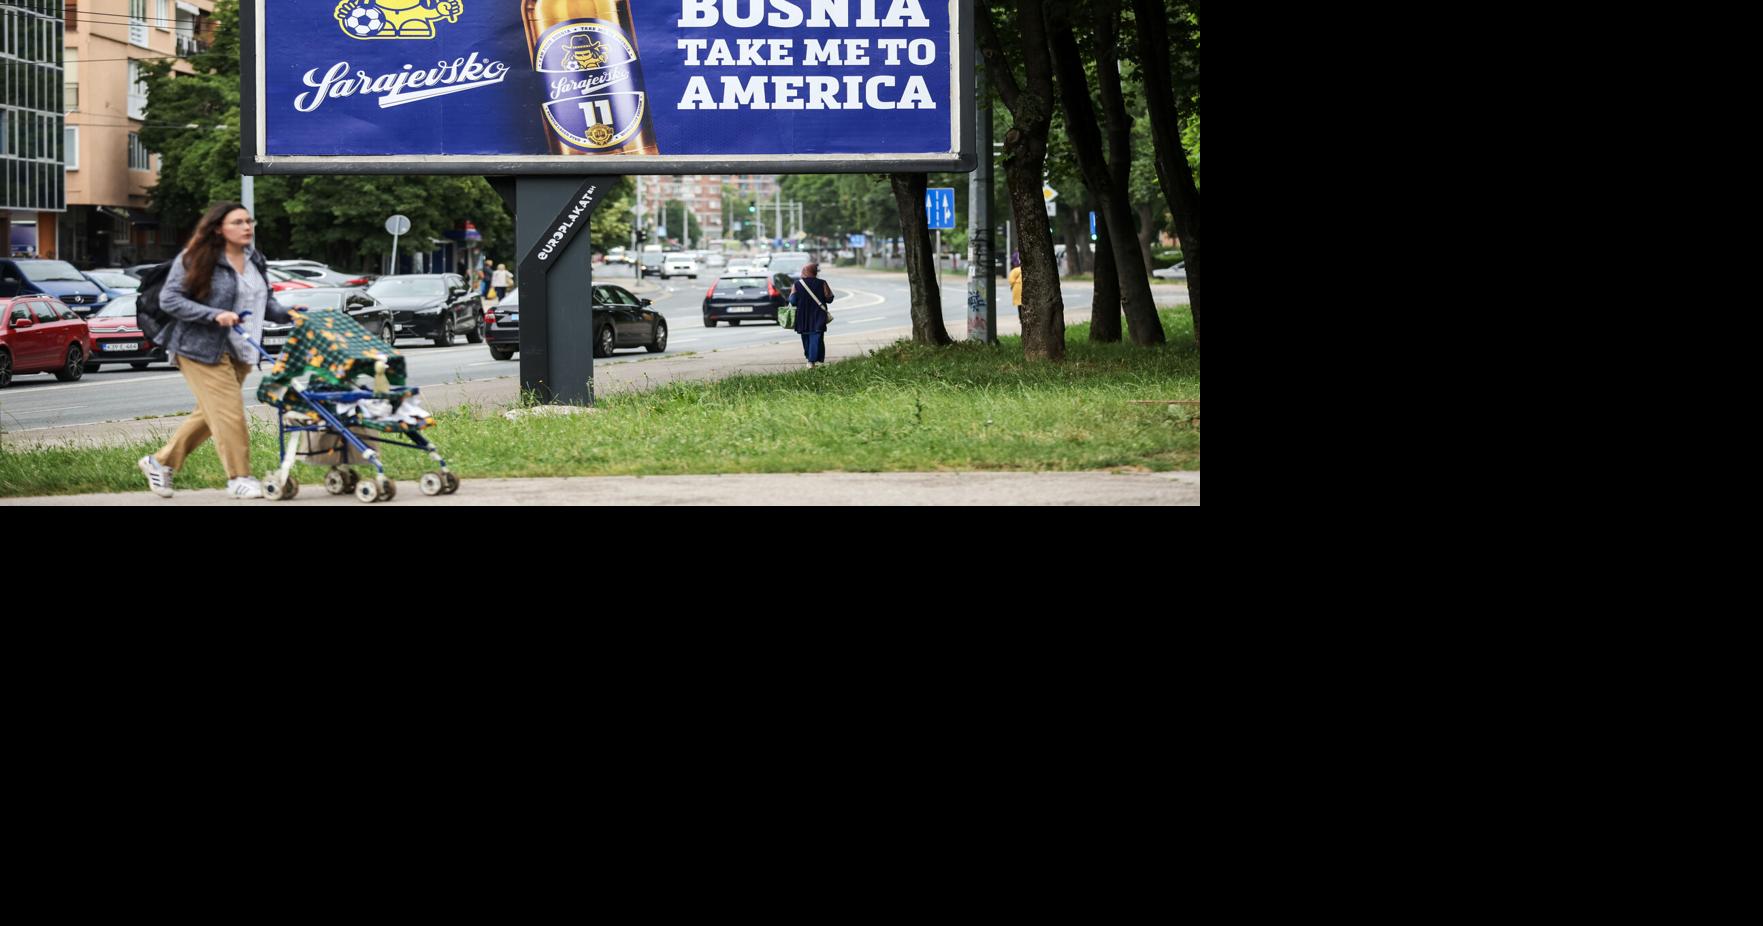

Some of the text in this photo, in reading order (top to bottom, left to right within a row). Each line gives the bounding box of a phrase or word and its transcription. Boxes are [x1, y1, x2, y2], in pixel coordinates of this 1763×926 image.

[677, 0, 930, 28] BOSNIA
[677, 38, 937, 66] TAKE ME TO
[293, 51, 511, 113] Sarajevsko
[550, 66, 630, 100] Sarajevsko
[677, 75, 937, 110] AMERICA
[578, 100, 614, 127] 11
